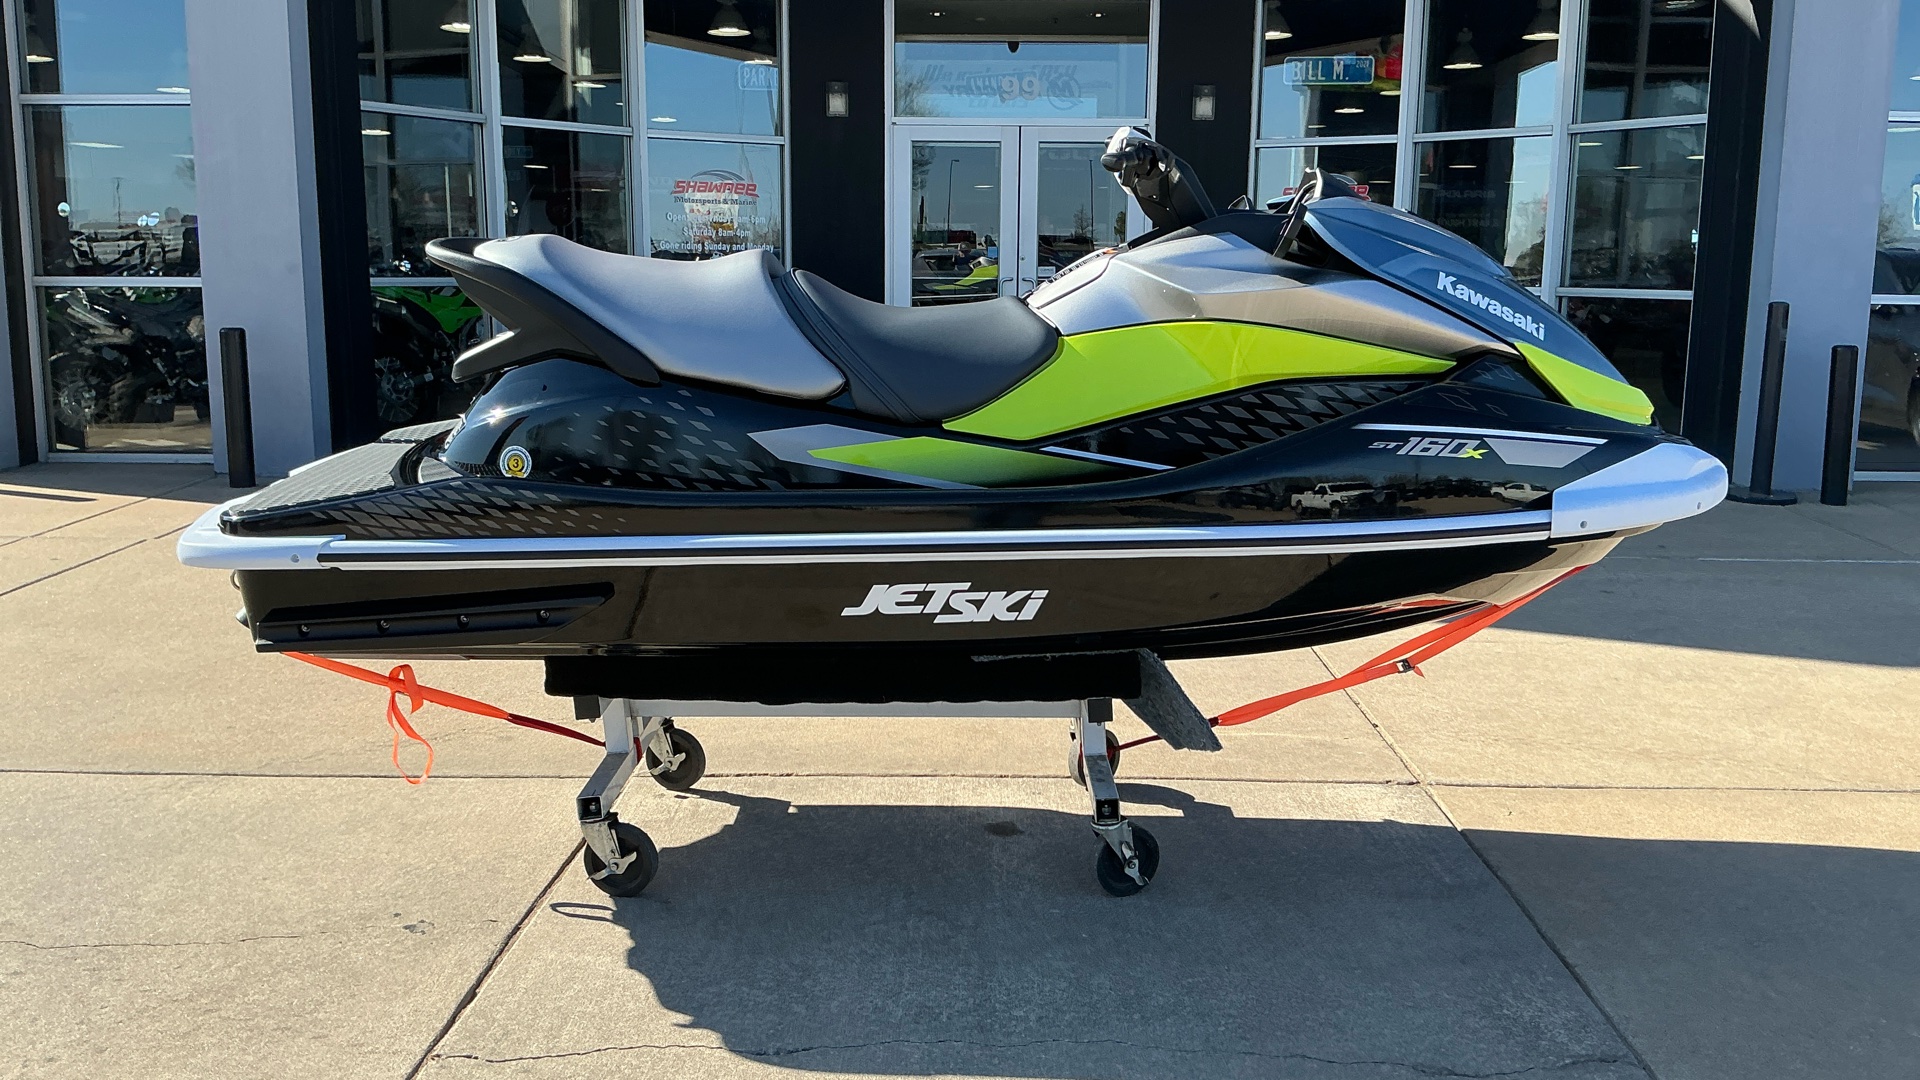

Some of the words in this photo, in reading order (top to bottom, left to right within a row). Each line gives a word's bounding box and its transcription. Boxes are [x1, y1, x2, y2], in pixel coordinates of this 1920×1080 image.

[1292, 60, 1326, 80] BILL
[1333, 60, 1349, 80] M.
[1001, 75, 1040, 101] 99
[674, 196, 722, 205] Motorsports
[730, 198, 757, 206] Marine
[666, 212, 687, 222] Open
[683, 227, 716, 237] Saturday
[718, 228, 751, 237] 8am-4pm
[660, 241, 680, 249] Gone
[681, 242, 702, 251] riding
[704, 242, 730, 251] Sunday
[1437, 271, 1545, 341] Kawasaki
[1368, 441, 1404, 449] ST
[512, 458, 519, 468] 3
[841, 582, 972, 616] JET
